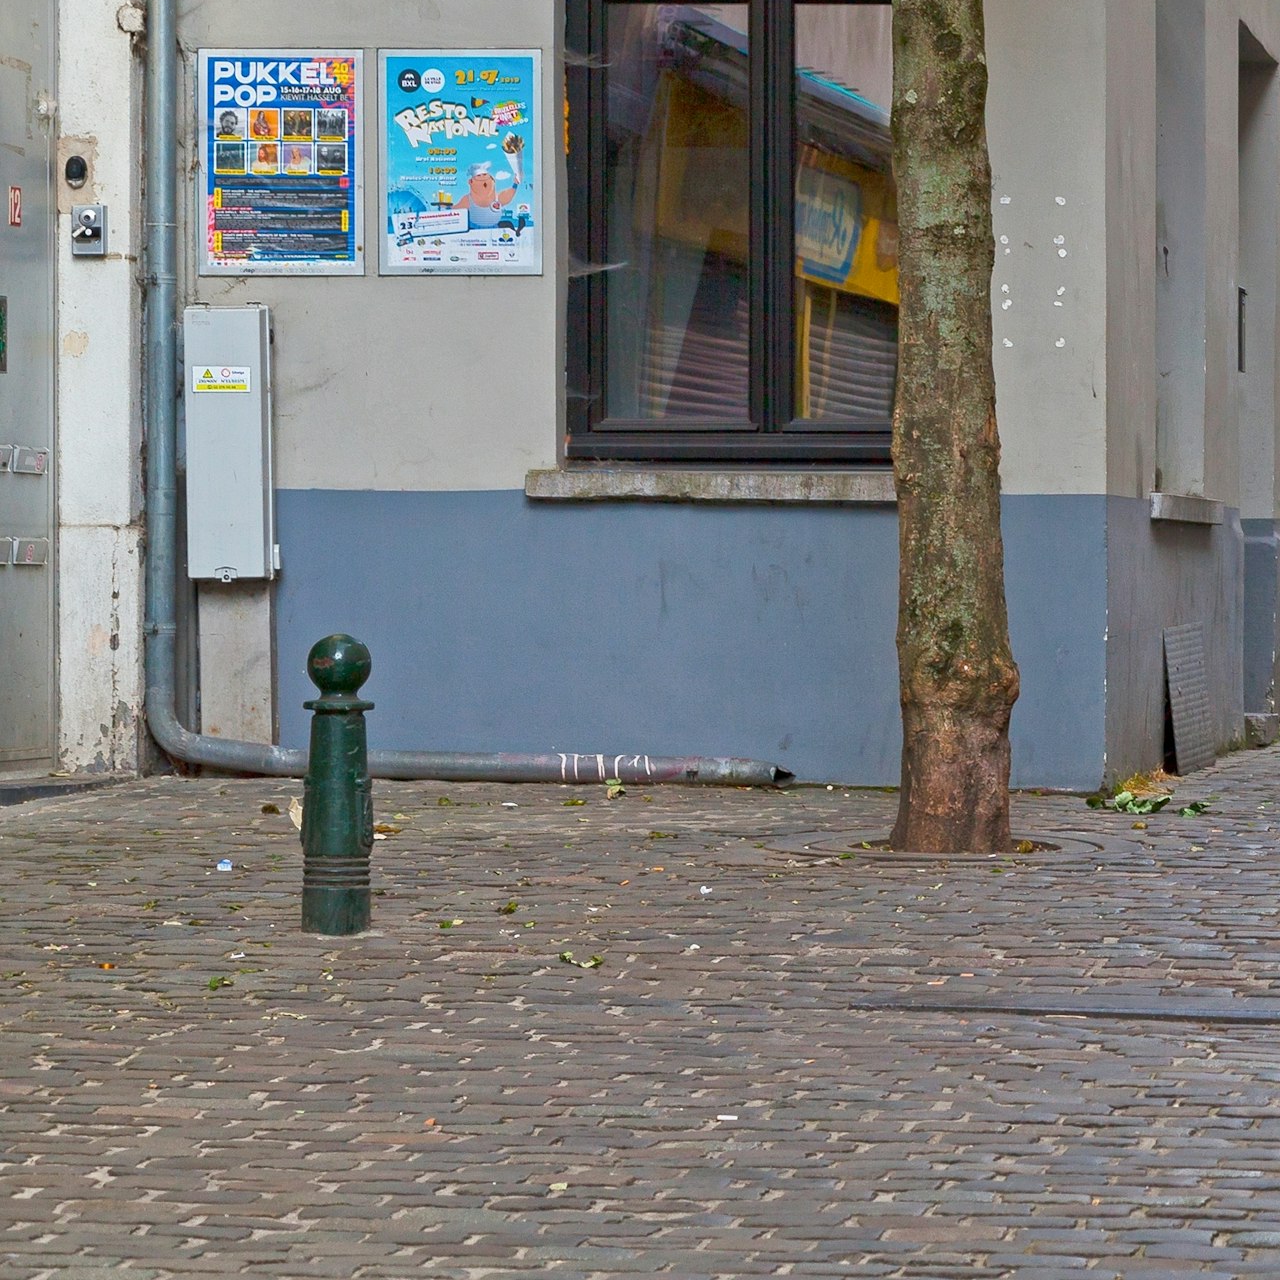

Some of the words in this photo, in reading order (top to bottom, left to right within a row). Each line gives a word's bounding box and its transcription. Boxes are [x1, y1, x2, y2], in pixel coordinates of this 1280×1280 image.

[214, 61, 334, 85] PUKKEL
[214, 84, 277, 107] POP
[280, 94, 305, 102] KIEWIT
[307, 94, 338, 102] HASSELT
[323, 86, 342, 94] AUG
[394, 99, 468, 131] RESTO
[404, 117, 499, 148] NATIONAL
